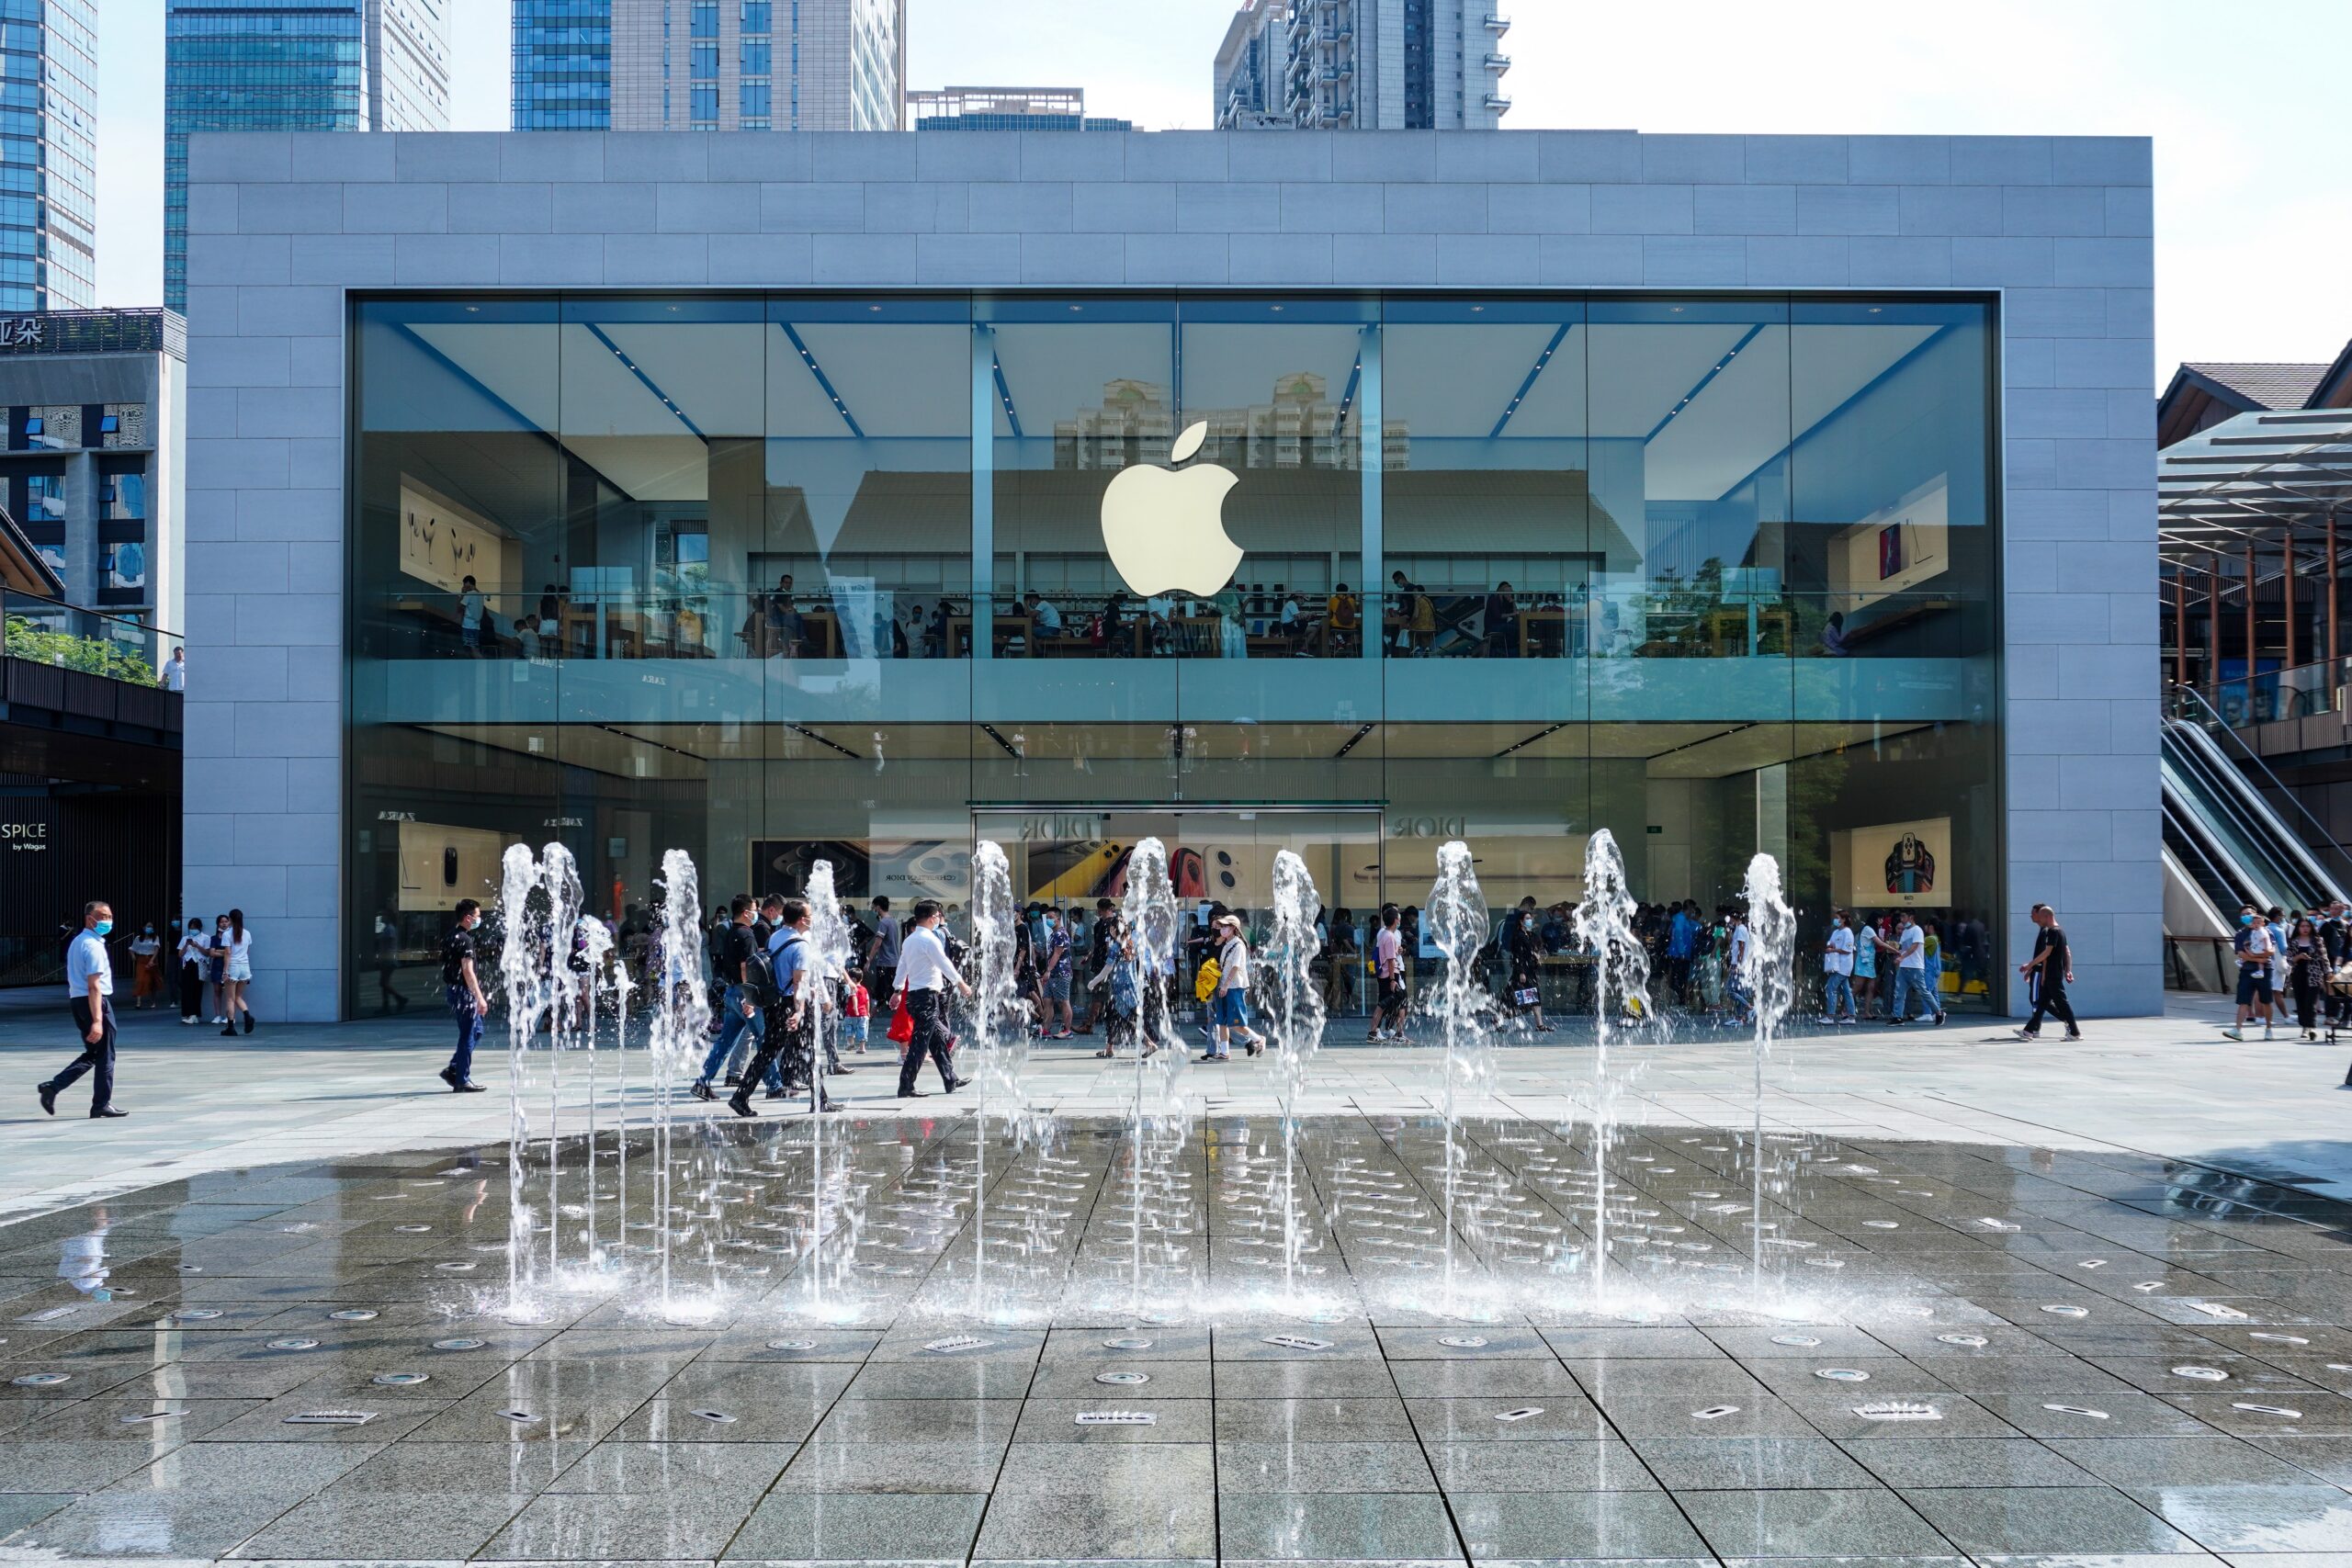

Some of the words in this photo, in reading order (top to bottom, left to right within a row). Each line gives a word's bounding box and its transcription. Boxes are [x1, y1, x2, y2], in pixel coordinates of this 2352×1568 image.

[2, 823, 46, 838] SPICE
[13, 843, 22, 852] by
[23, 843, 46, 852] Wagas
